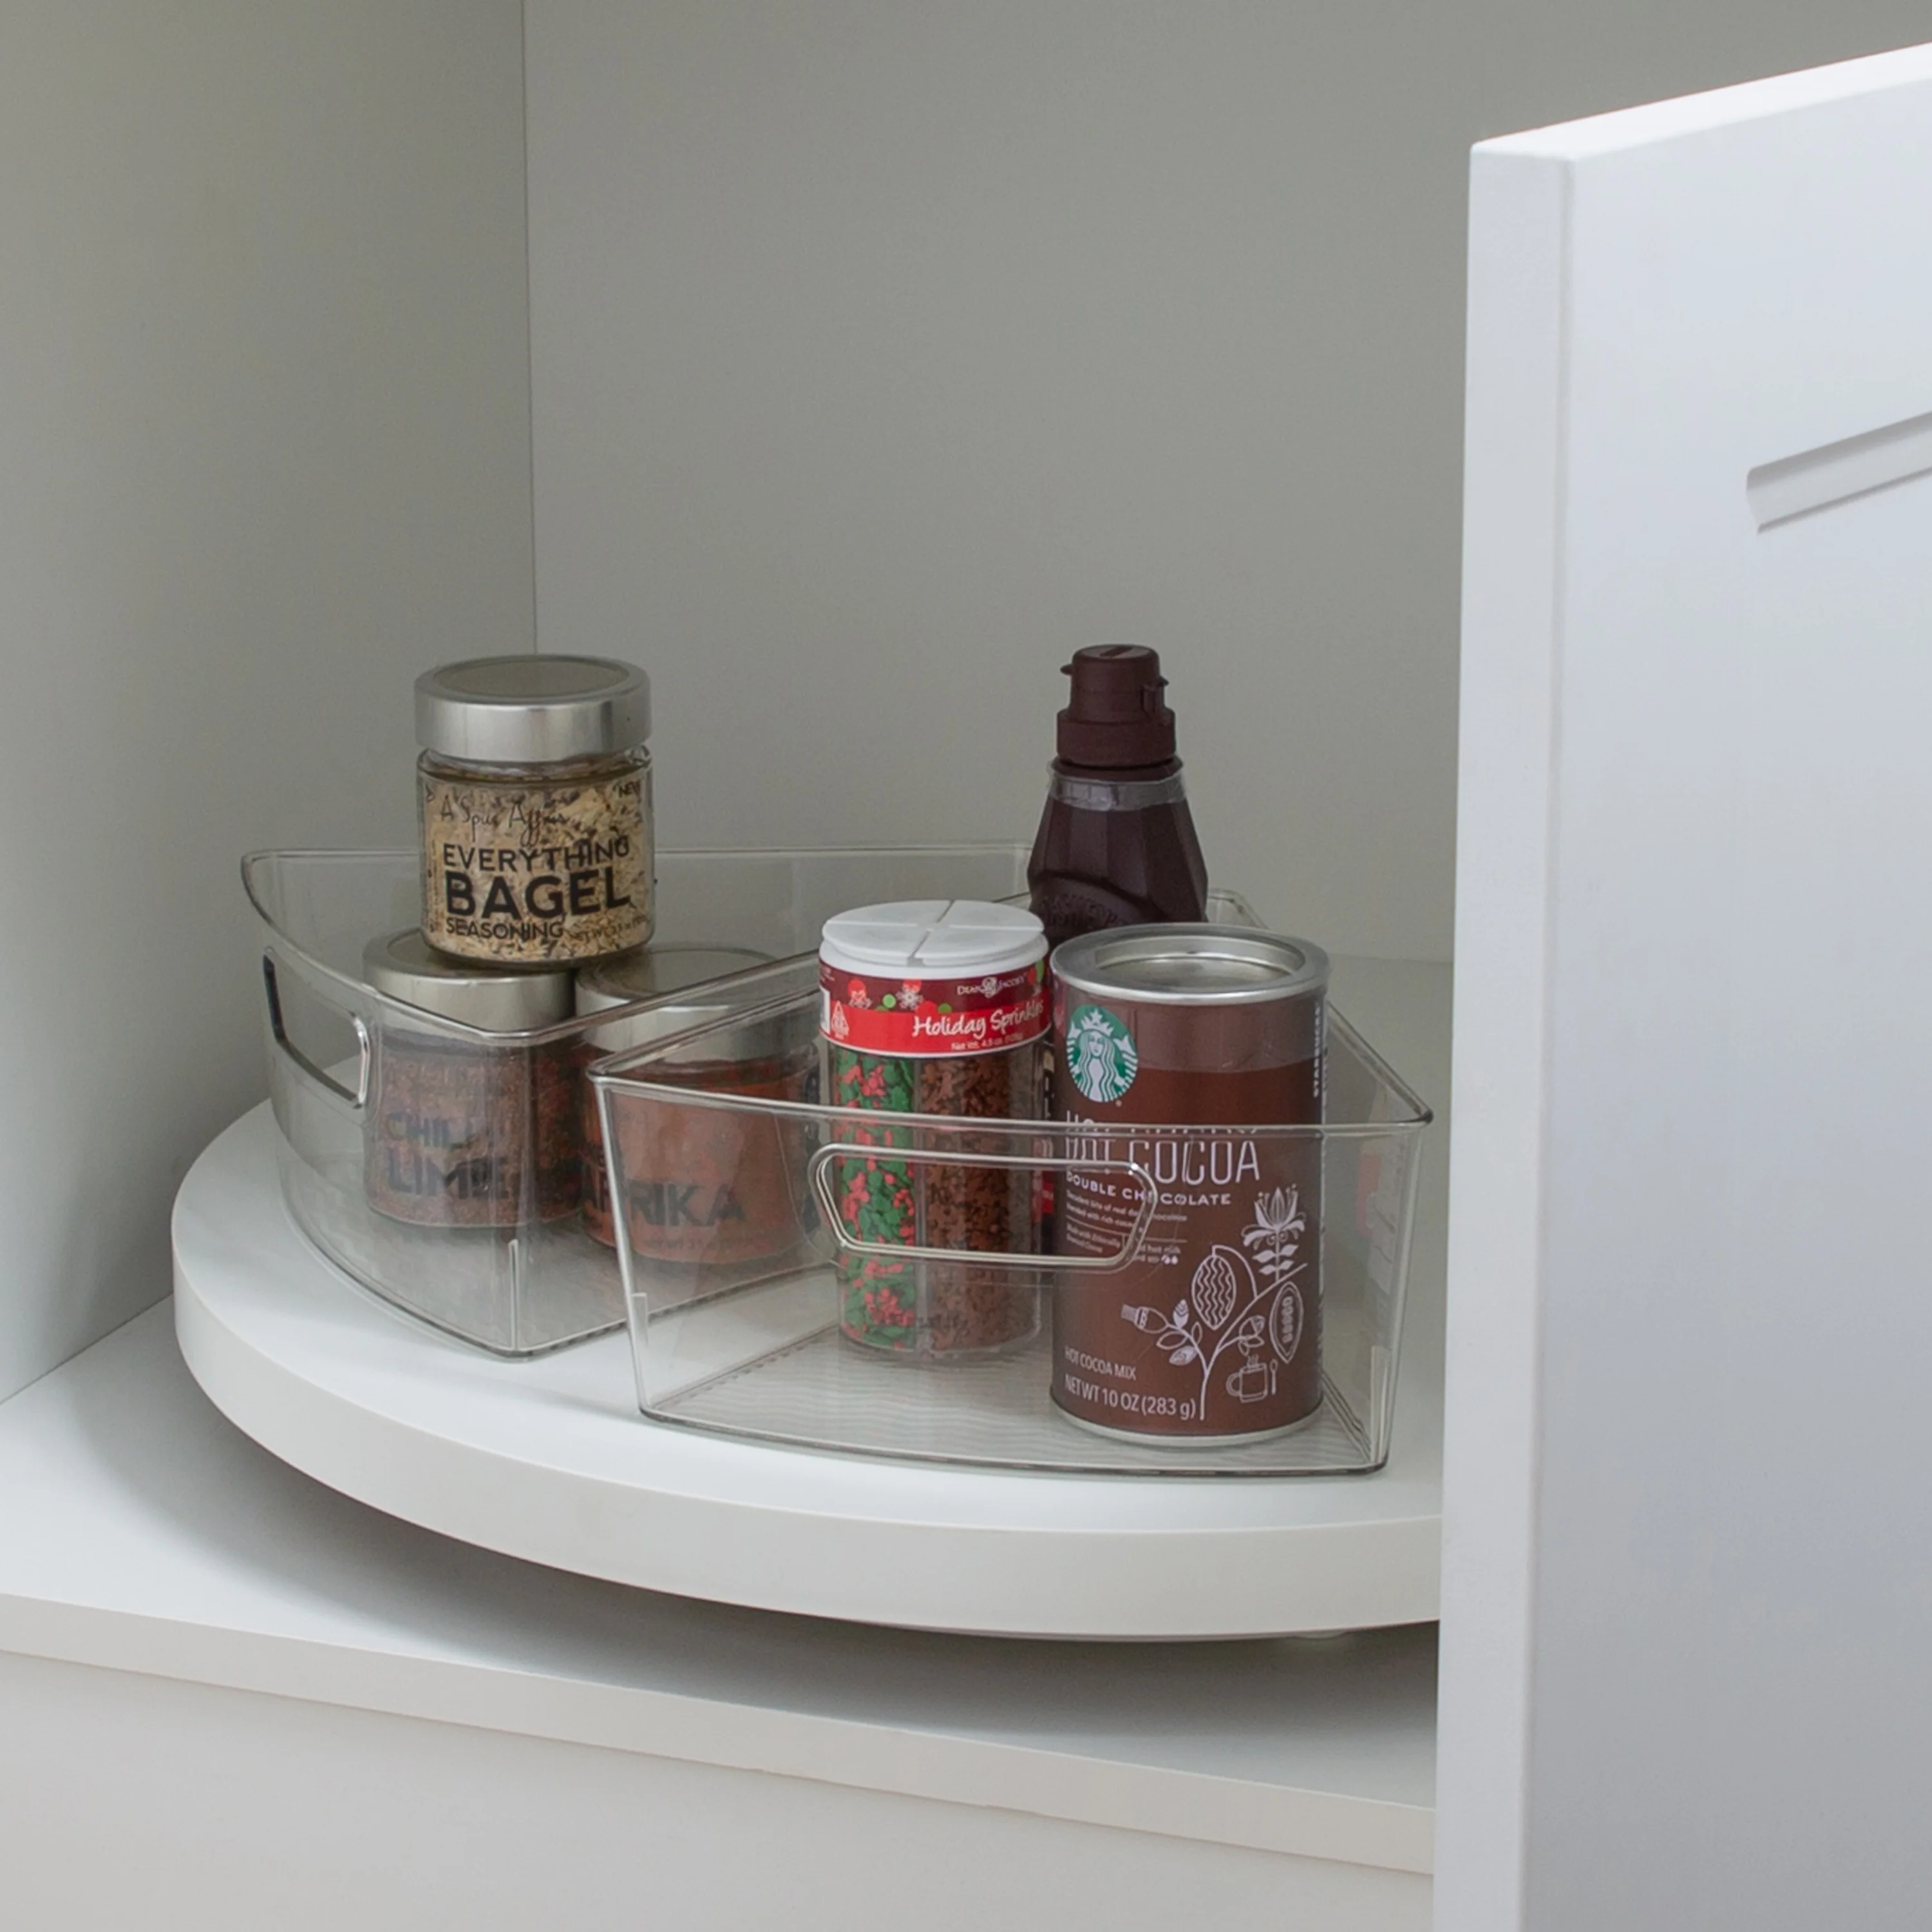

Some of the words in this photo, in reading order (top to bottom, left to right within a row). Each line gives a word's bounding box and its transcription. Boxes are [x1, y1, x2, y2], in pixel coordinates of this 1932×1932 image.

[443, 835, 630, 872] EVERYTHING
[445, 866, 632, 920] BAGEL
[446, 918, 564, 942] SEASONING
[911, 1014, 986, 1040] Holiday
[990, 999, 1044, 1035] Sprinkles
[388, 1147, 509, 1199] LIME
[1128, 1129, 1260, 1186] COCOA
[1066, 1172, 1117, 1197] DOUBLE
[1122, 1188, 1231, 1206] CHCOLATE
[1065, 1345, 1079, 1365] HOT
[1080, 1352, 1113, 1376] COCOA
[1114, 1362, 1137, 1381] MIX
[1065, 1374, 1081, 1396] NET
[1081, 1382, 1100, 1403] WT
[1102, 1388, 1119, 1408] 10
[1121, 1392, 1141, 1412] OZ
[1142, 1395, 1177, 1416] (283
[1180, 1398, 1197, 1421] g)
